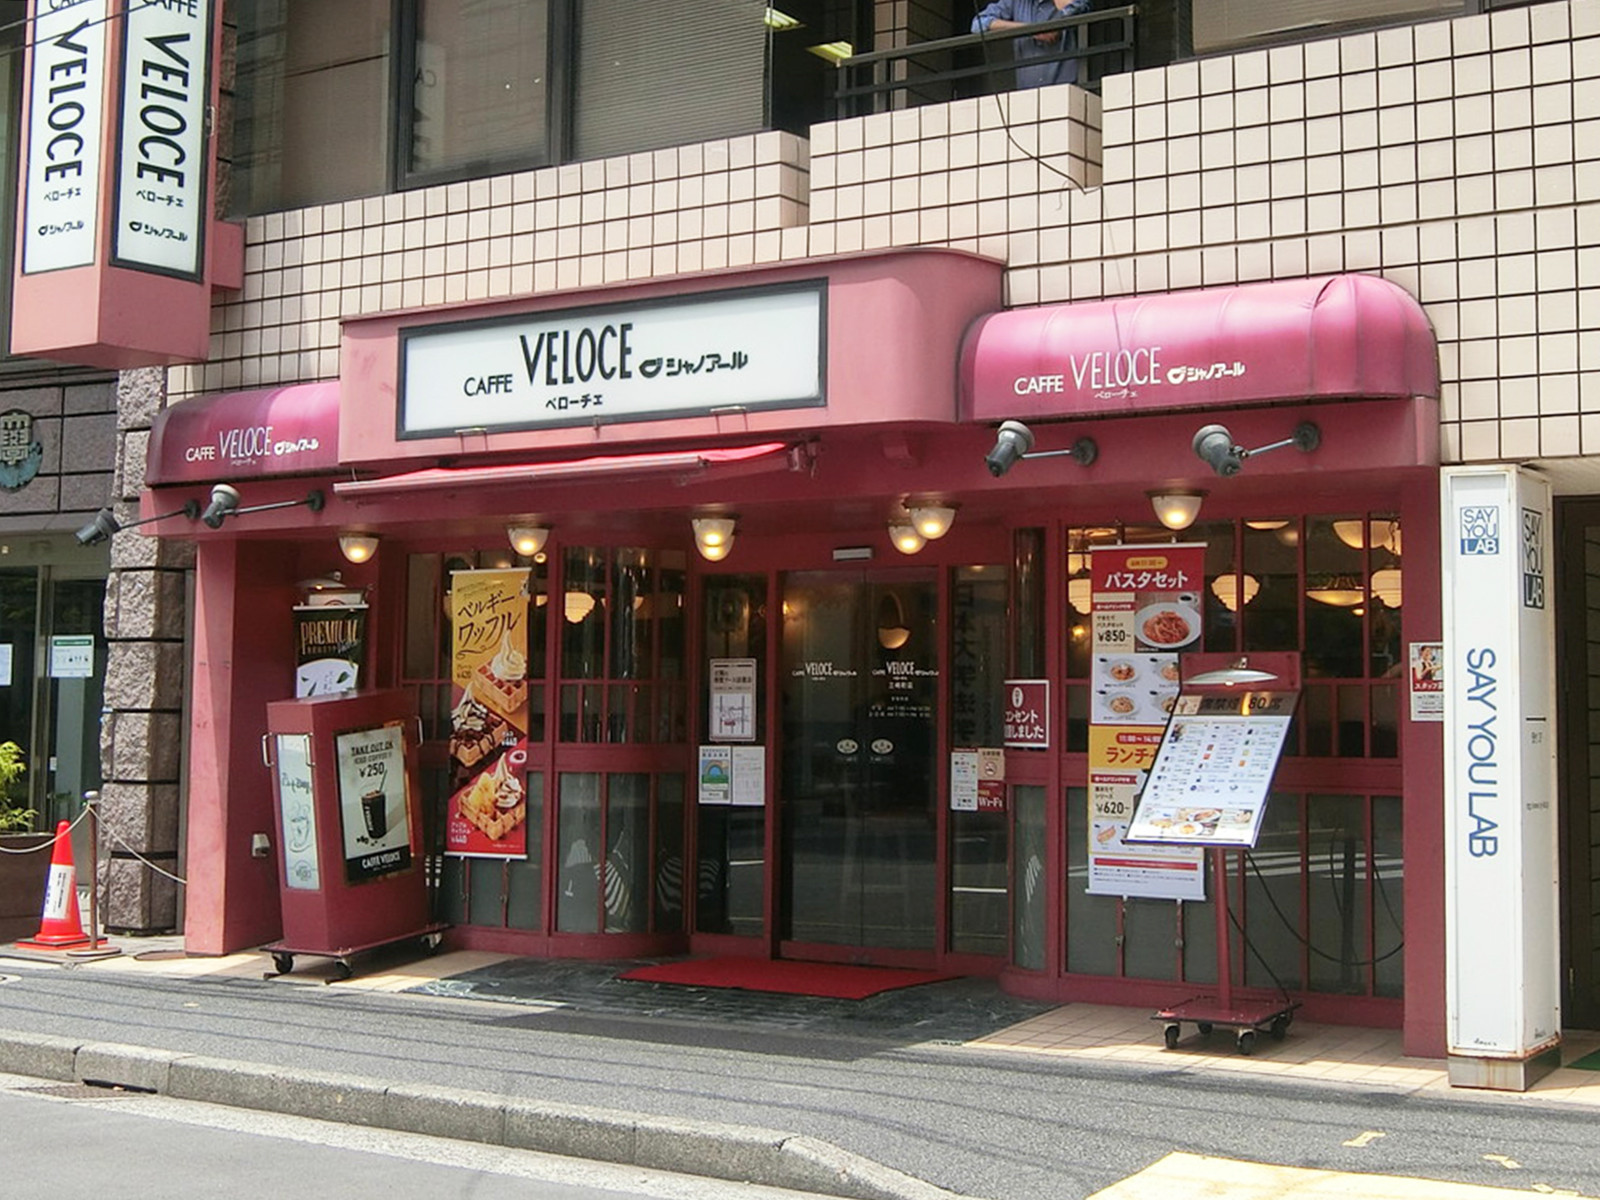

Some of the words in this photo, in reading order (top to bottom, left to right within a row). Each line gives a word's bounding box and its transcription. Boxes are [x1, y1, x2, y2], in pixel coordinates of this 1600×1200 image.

[45, 18, 90, 182] VELOCE
[136, 32, 191, 188] VELOCE
[136, 190, 184, 207] ベローチェ
[463, 374, 513, 397] CAFFE
[519, 322, 633, 387] VELOCE
[666, 350, 749, 376] シャノアール
[1014, 374, 1064, 395] CAFFE
[1070, 346, 1162, 390] VELOCE
[1187, 361, 1246, 381] シャノアール
[545, 394, 604, 411] ベローチェ
[186, 446, 215, 461] CAFFE
[219, 426, 273, 459] VELOCE
[1463, 508, 1494, 524] SAY
[1463, 523, 1497, 538] YOU
[1464, 540, 1497, 555] LAB
[1105, 571, 1188, 589] パスタセット
[457, 589, 515, 617] ベルギー
[459, 611, 521, 648] ワッフル
[805, 662, 833, 676] VELOCE
[886, 661, 915, 675] VELOCE
[1466, 648, 1497, 711] SAY
[1106, 746, 1155, 764] ランチ
[1467, 715, 1497, 785] YOU
[359, 762, 385, 777] ¥250
[1468, 792, 1498, 858] LAB
